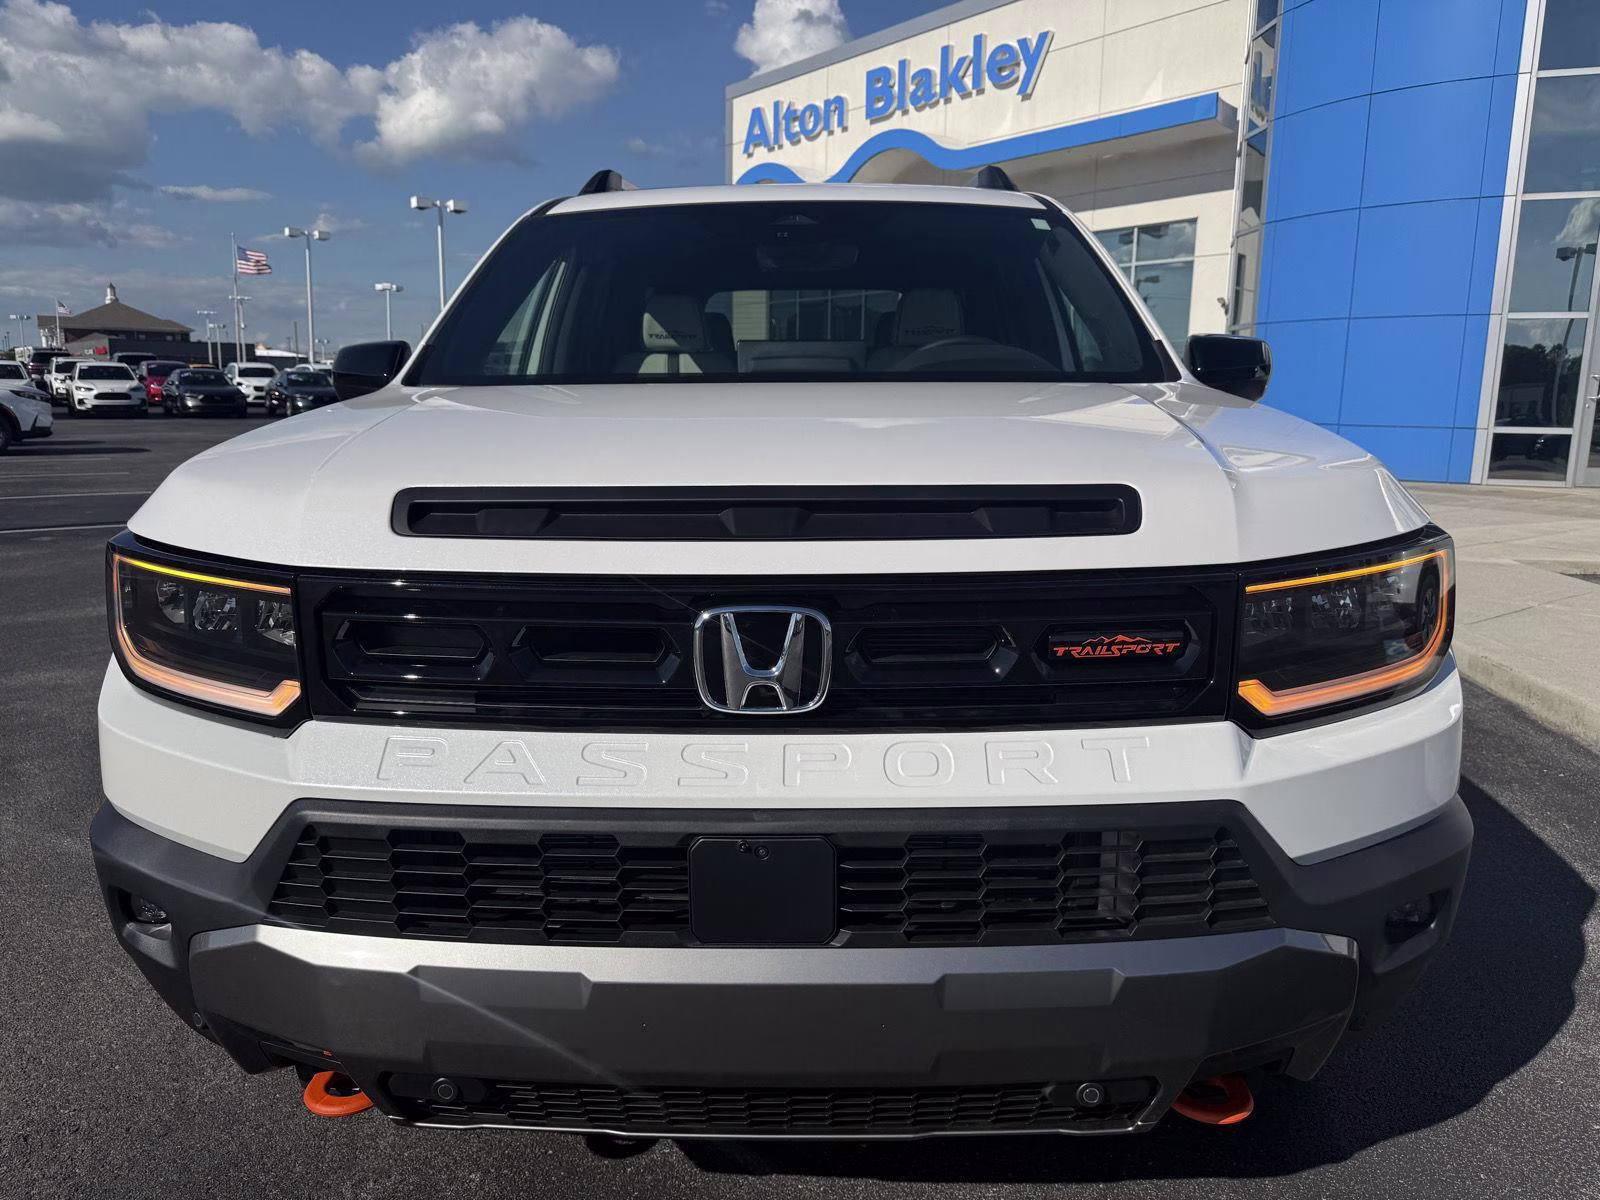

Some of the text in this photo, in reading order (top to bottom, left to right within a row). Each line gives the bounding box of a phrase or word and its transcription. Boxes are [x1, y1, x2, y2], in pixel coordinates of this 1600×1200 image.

[743, 31, 1053, 156] Alton Blakley
[1053, 642, 1180, 658] TRAILSPORT
[376, 736, 1150, 788] PASSPORT
